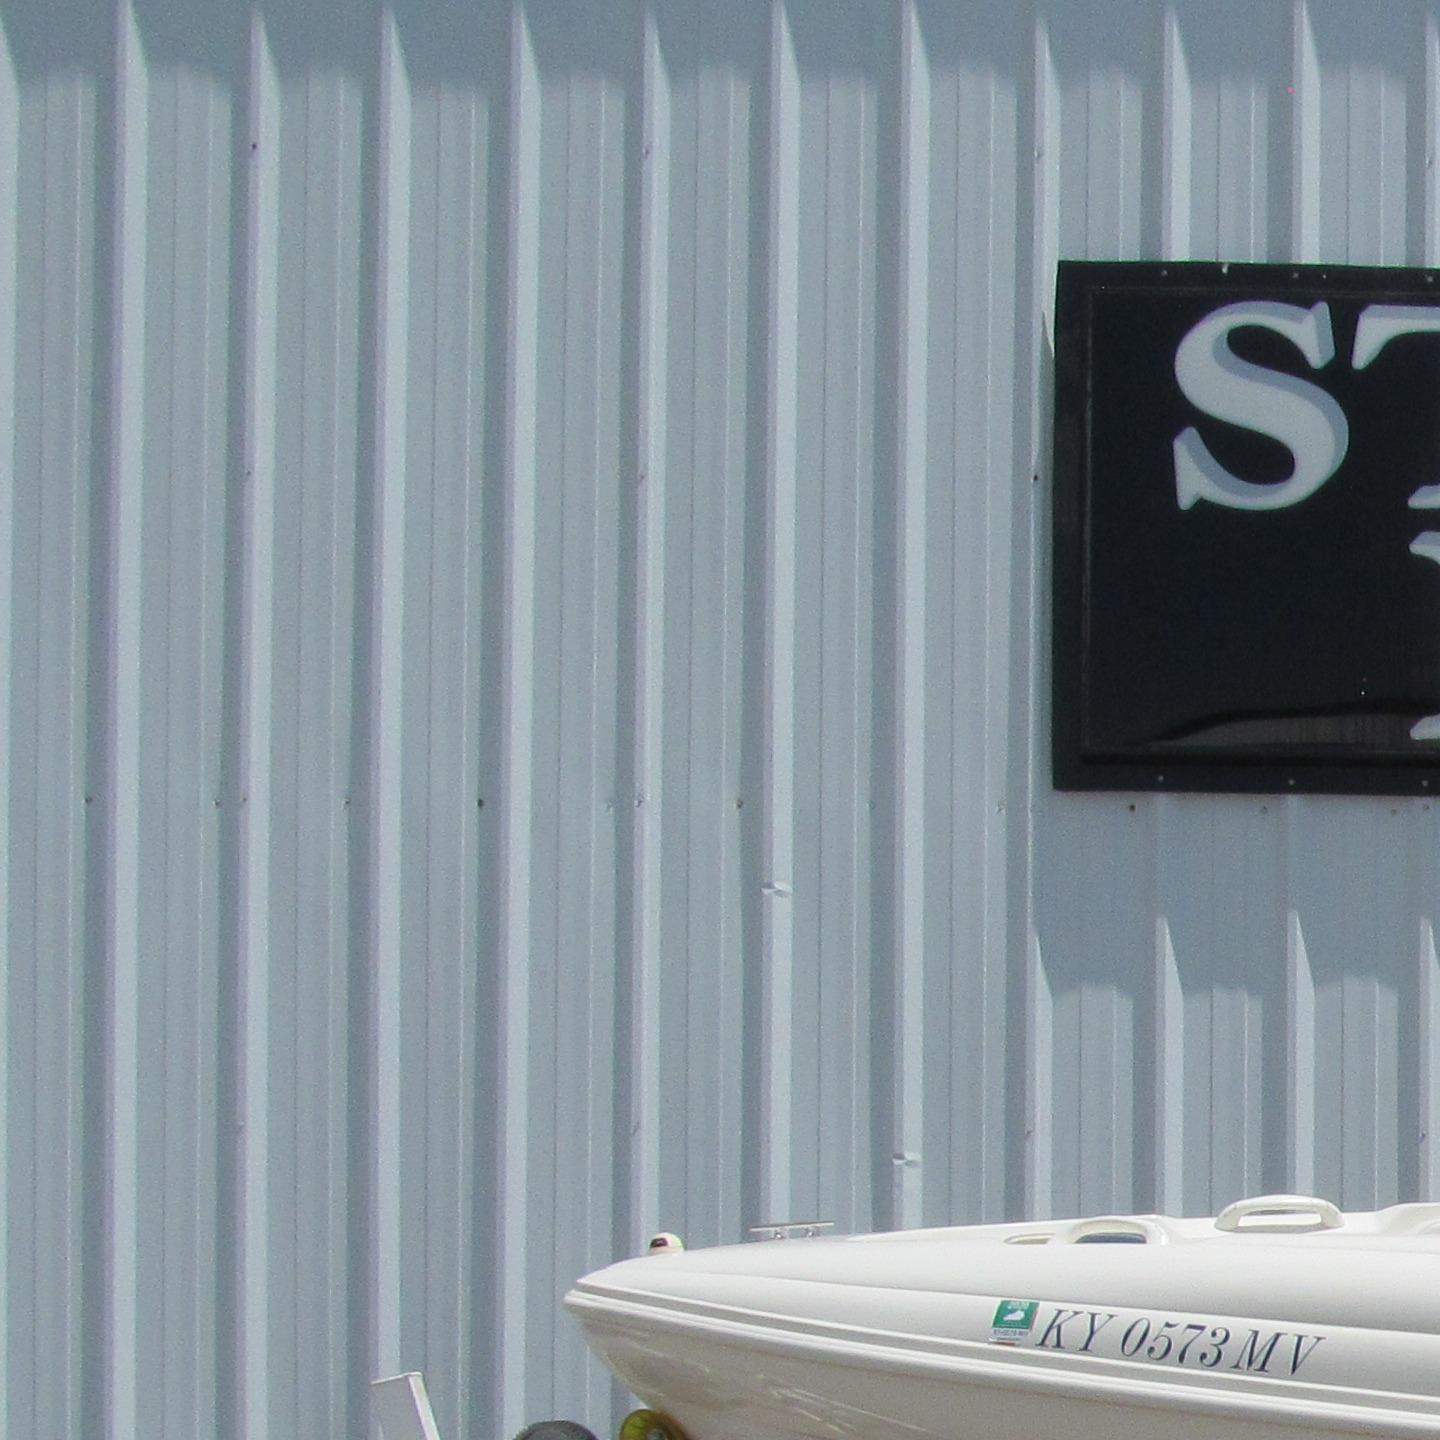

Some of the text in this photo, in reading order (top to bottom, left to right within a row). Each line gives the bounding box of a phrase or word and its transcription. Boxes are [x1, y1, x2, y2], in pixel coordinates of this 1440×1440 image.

[1035, 1308, 1326, 1376] KY 0573 MV
